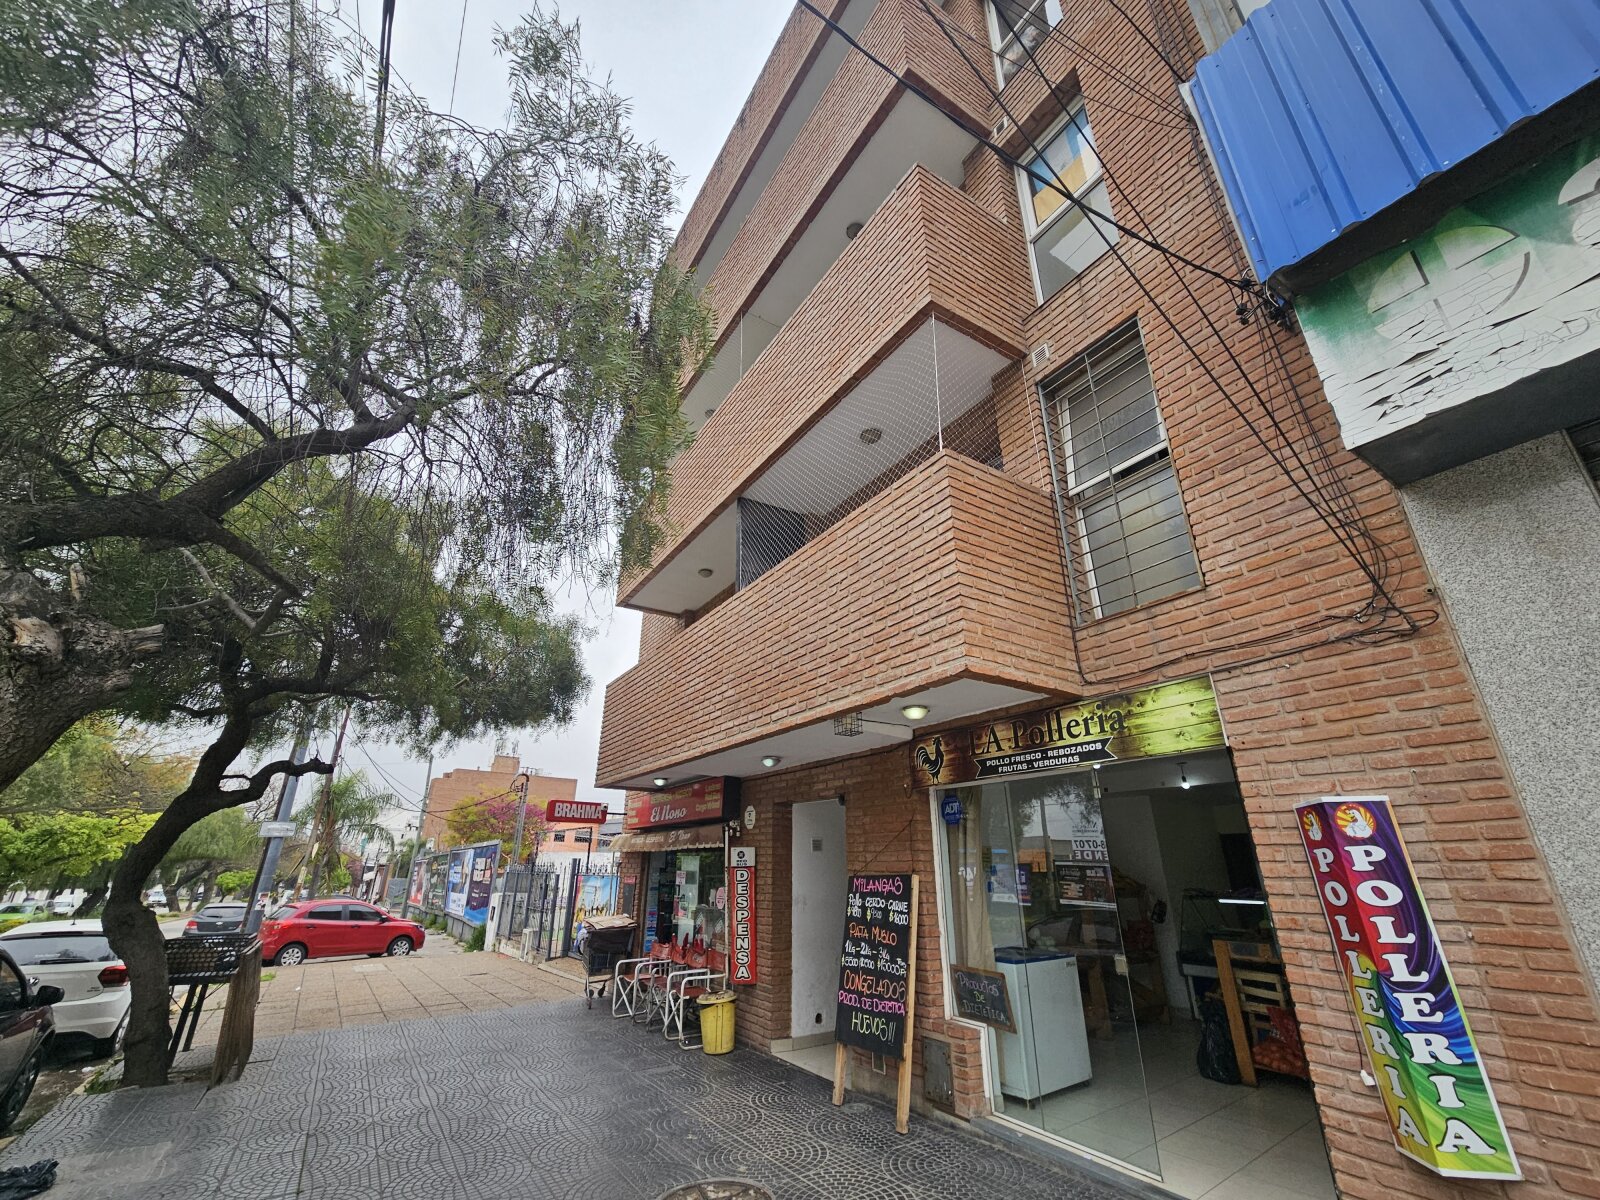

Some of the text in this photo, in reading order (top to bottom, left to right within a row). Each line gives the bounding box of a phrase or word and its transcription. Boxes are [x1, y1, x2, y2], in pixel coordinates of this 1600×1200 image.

[968, 703, 1128, 757] LA Polleria
[986, 757, 1010, 767] POLLO
[1011, 752, 1041, 764] FRESCO
[1047, 742, 1102, 758] REBOZADOS
[998, 762, 1027, 774] FRUTAS
[1033, 755, 1080, 768] VERDURAS
[554, 802, 602, 819] BRAHMA
[650, 807, 659, 822] El
[945, 801, 961, 814] ADT
[888, 900, 908, 912] CARNE
[735, 869, 750, 980] DESPENSA
[849, 922, 897, 946] PATA MUSLO
[844, 969, 906, 1002] CONGELADOS
[1313, 848, 1429, 1147] POLLERIA
[861, 997, 872, 1010] DE
[873, 998, 905, 1016] DIETETICA
[1344, 844, 1497, 1155] POLLERIA
